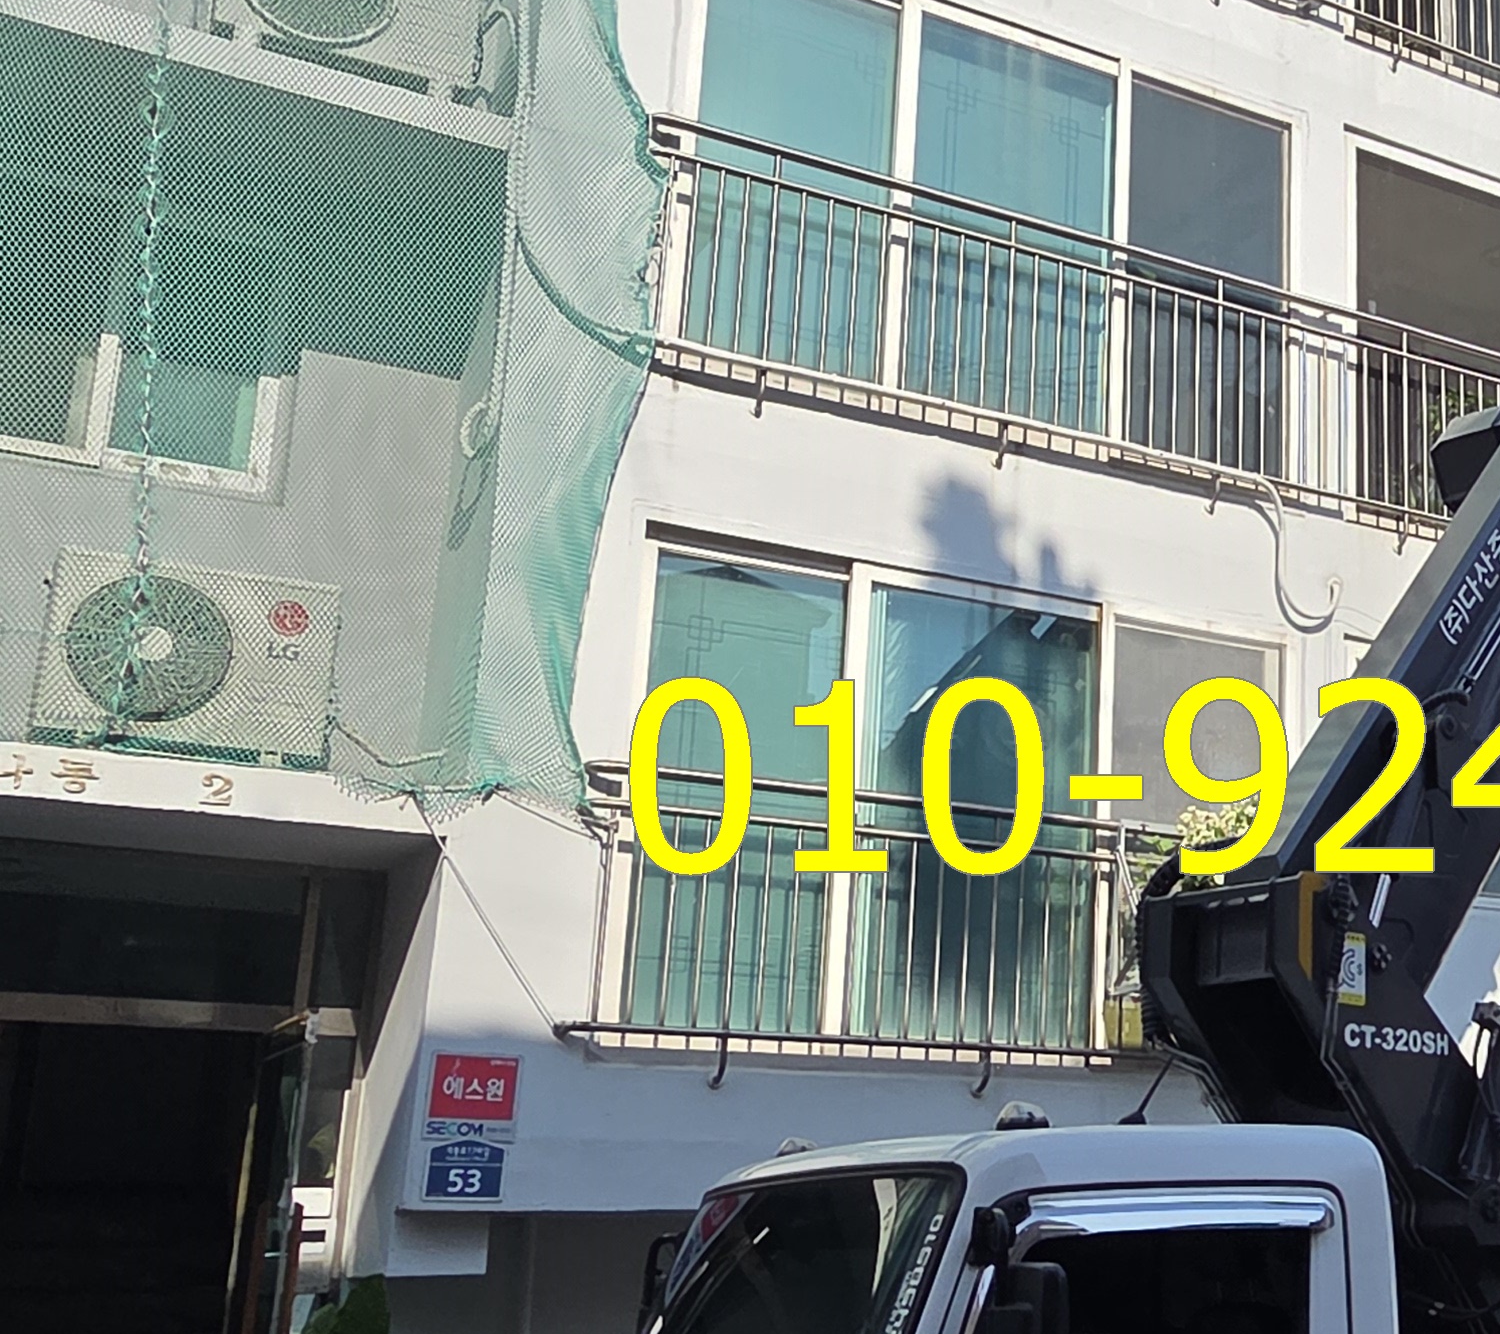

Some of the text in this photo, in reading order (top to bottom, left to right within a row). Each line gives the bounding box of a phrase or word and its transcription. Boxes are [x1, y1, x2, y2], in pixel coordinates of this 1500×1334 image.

[199, 772, 234, 807] 2
[1344, 1023, 1450, 1056] CT-320SH
[442, 1072, 505, 1102] 에스원
[446, 1168, 482, 1193] 53
